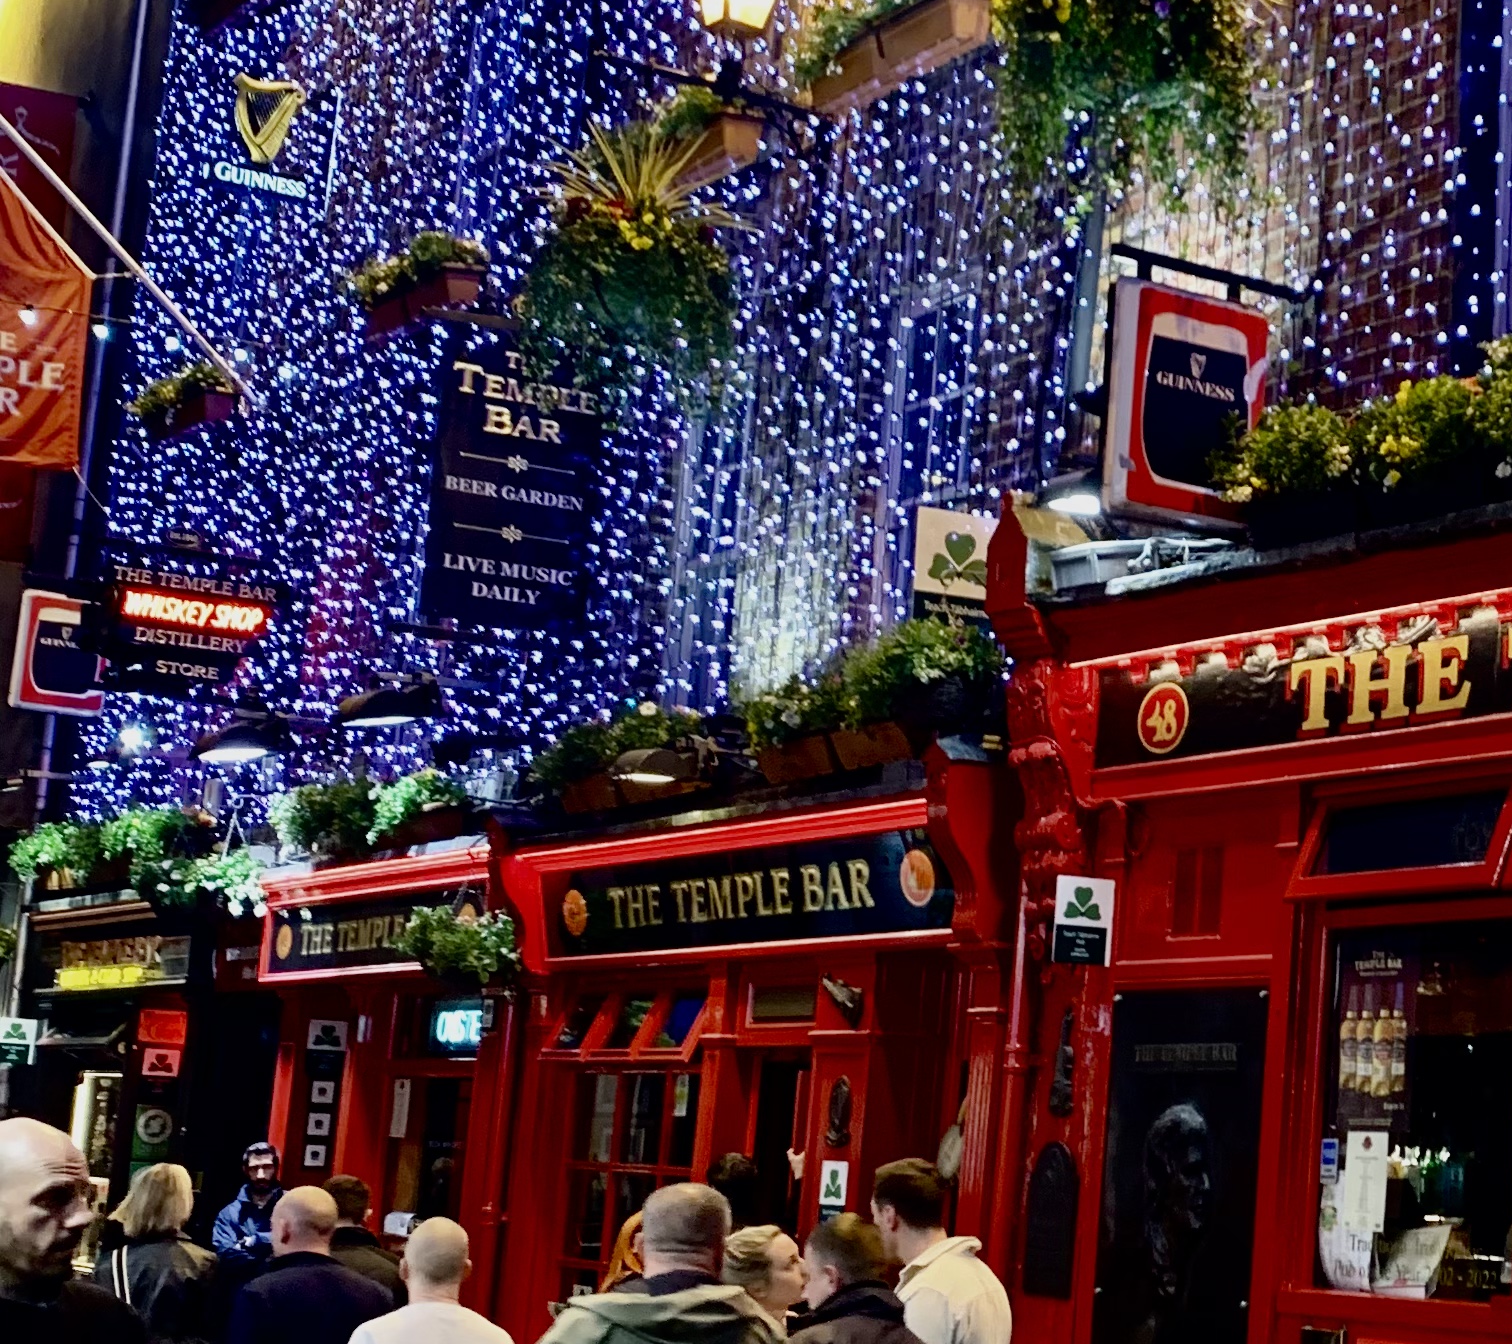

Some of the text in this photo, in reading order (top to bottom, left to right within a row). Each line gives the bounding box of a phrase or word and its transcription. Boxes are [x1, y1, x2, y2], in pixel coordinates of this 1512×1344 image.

[214, 162, 307, 199] GUINNESS
[0, 359, 66, 393] PLE
[1156, 370, 1235, 402] GUINNESS
[483, 403, 562, 445] BAR
[445, 475, 584, 512] BEER GARDEN
[114, 565, 277, 602] THE TEMPLE BAR
[443, 552, 574, 586] LIVE MUSIC
[124, 591, 264, 631] WHISKEY SHOP
[471, 581, 541, 605] DAILY
[134, 626, 248, 654] DISTILLERY
[155, 660, 220, 680] STORE
[1288, 634, 1472, 731] THE
[1147, 698, 1178, 744] 48
[607, 858, 875, 929] THE TEMPLE BAR
[301, 923, 334, 956] THE
